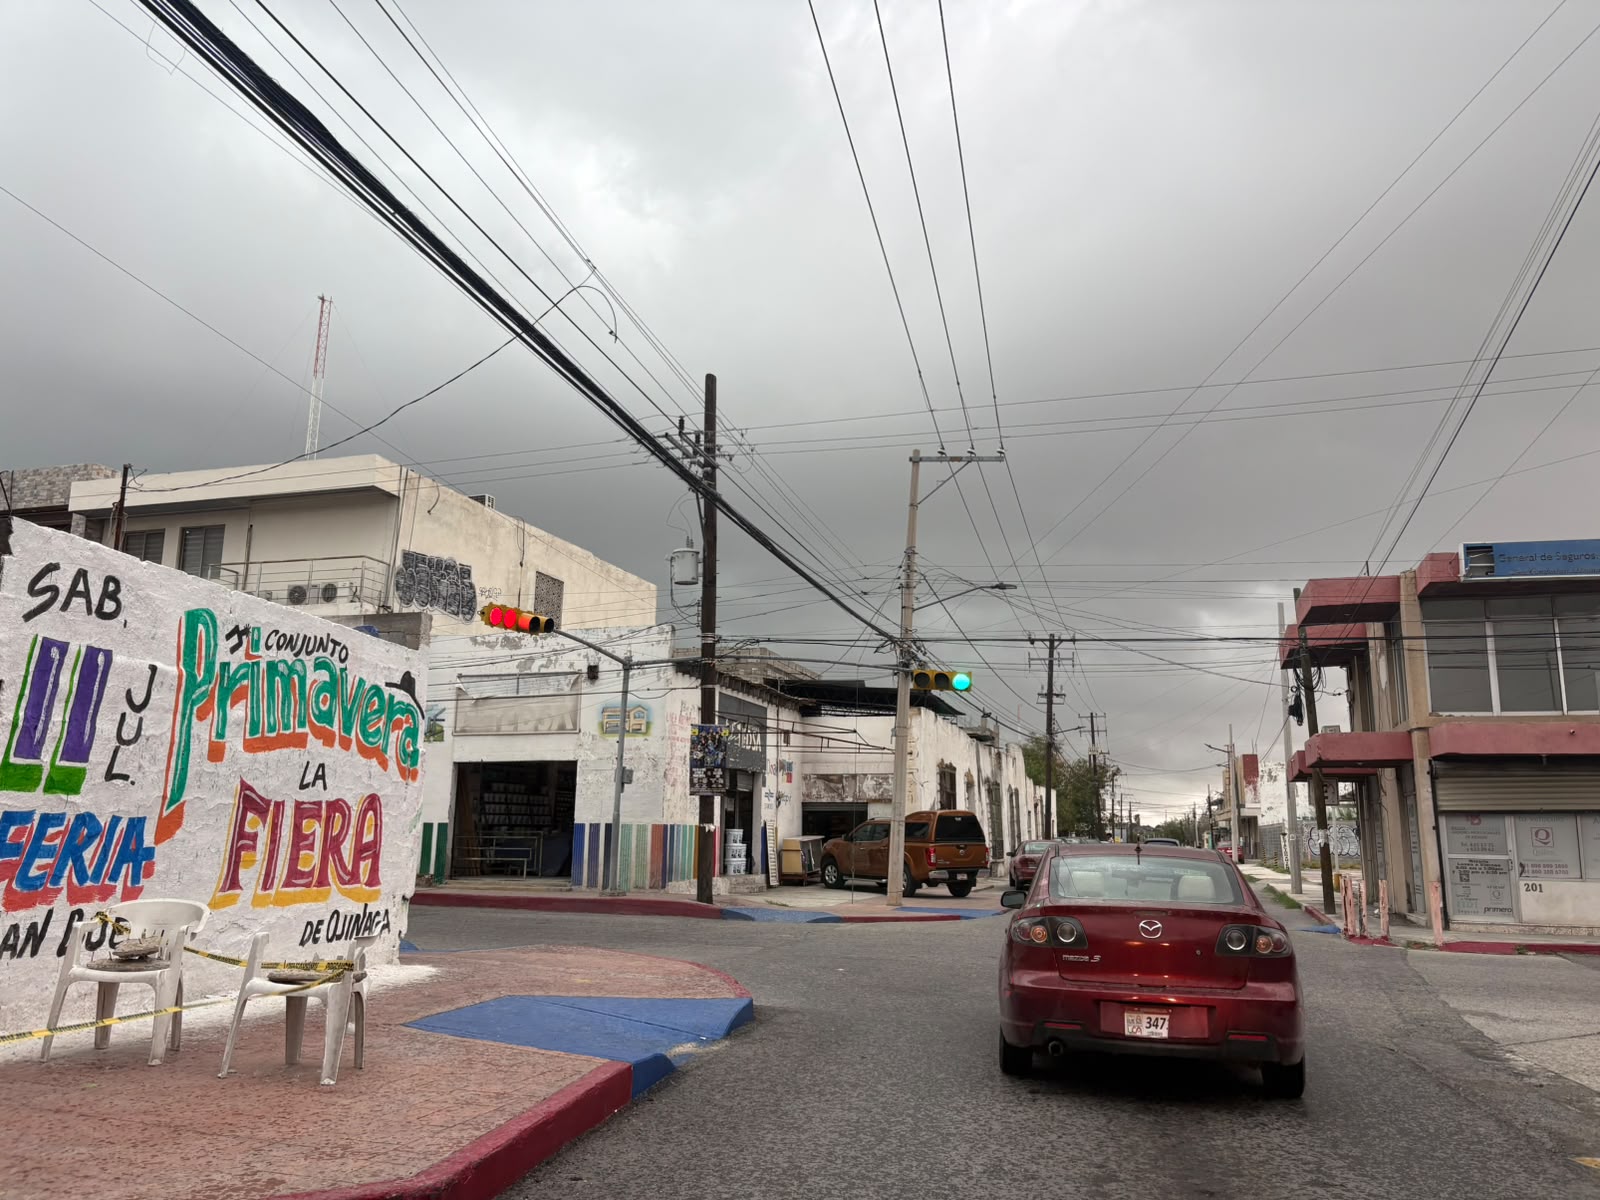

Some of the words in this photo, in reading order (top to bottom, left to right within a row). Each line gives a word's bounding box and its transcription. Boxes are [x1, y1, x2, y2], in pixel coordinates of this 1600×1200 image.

[1540, 552, 1553, 562] de
[264, 629, 350, 664] CONJUNTO
[162, 608, 421, 822] Primavera
[299, 761, 327, 790] LA
[0, 809, 156, 898] FERIA
[212, 777, 382, 902] FIERA
[1524, 883, 1543, 893] 201
[298, 920, 325, 947] DE
[326, 903, 391, 944] OJINAGA
[1145, 1016, 1168, 1030] 347
